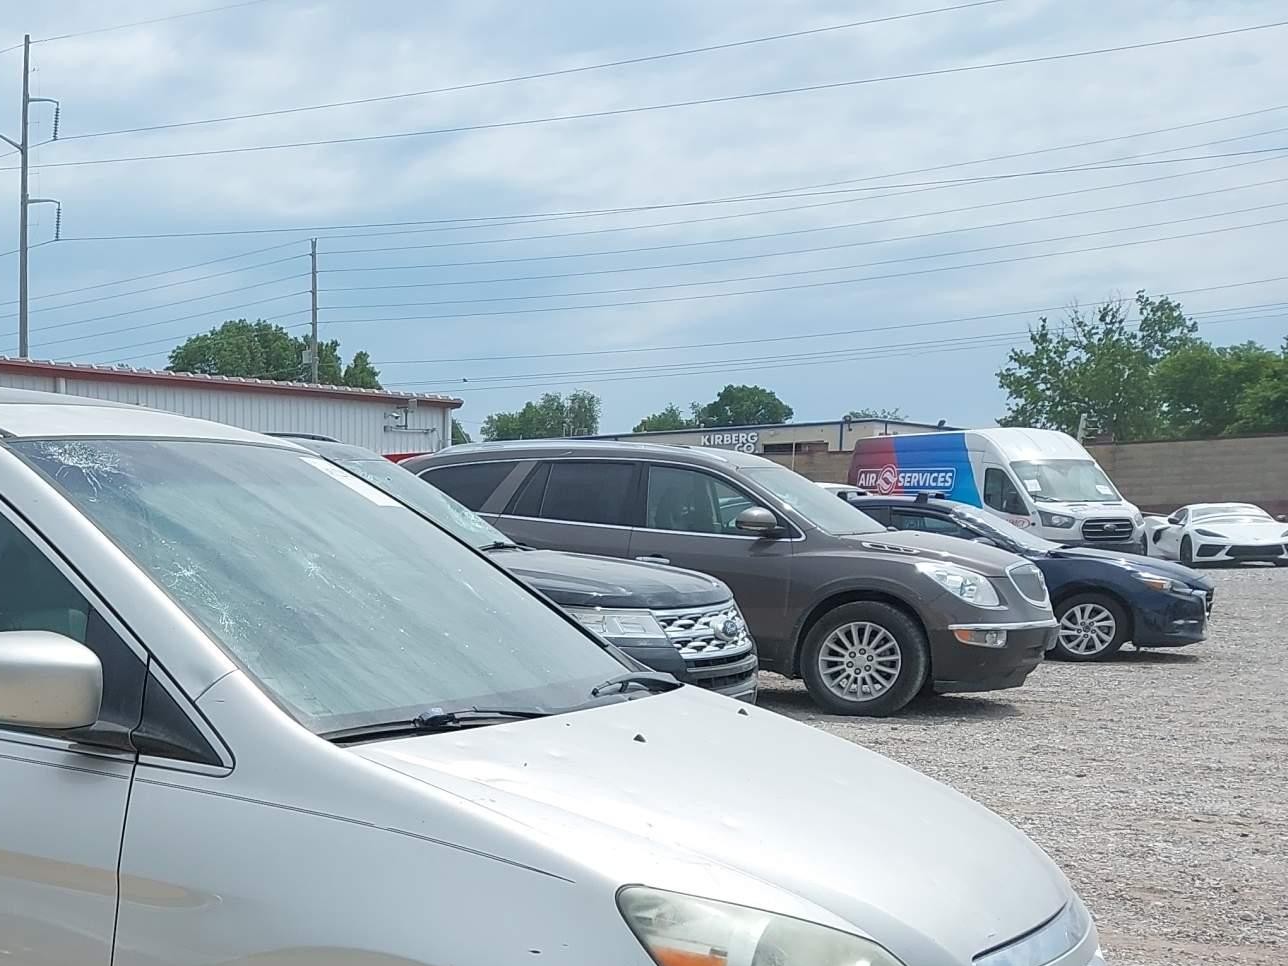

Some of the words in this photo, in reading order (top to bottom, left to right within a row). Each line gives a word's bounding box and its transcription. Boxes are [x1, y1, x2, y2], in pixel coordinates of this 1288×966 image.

[701, 432, 758, 446] KIRBERG
[858, 472, 877, 487] AIR
[898, 472, 952, 487] SERVICES
